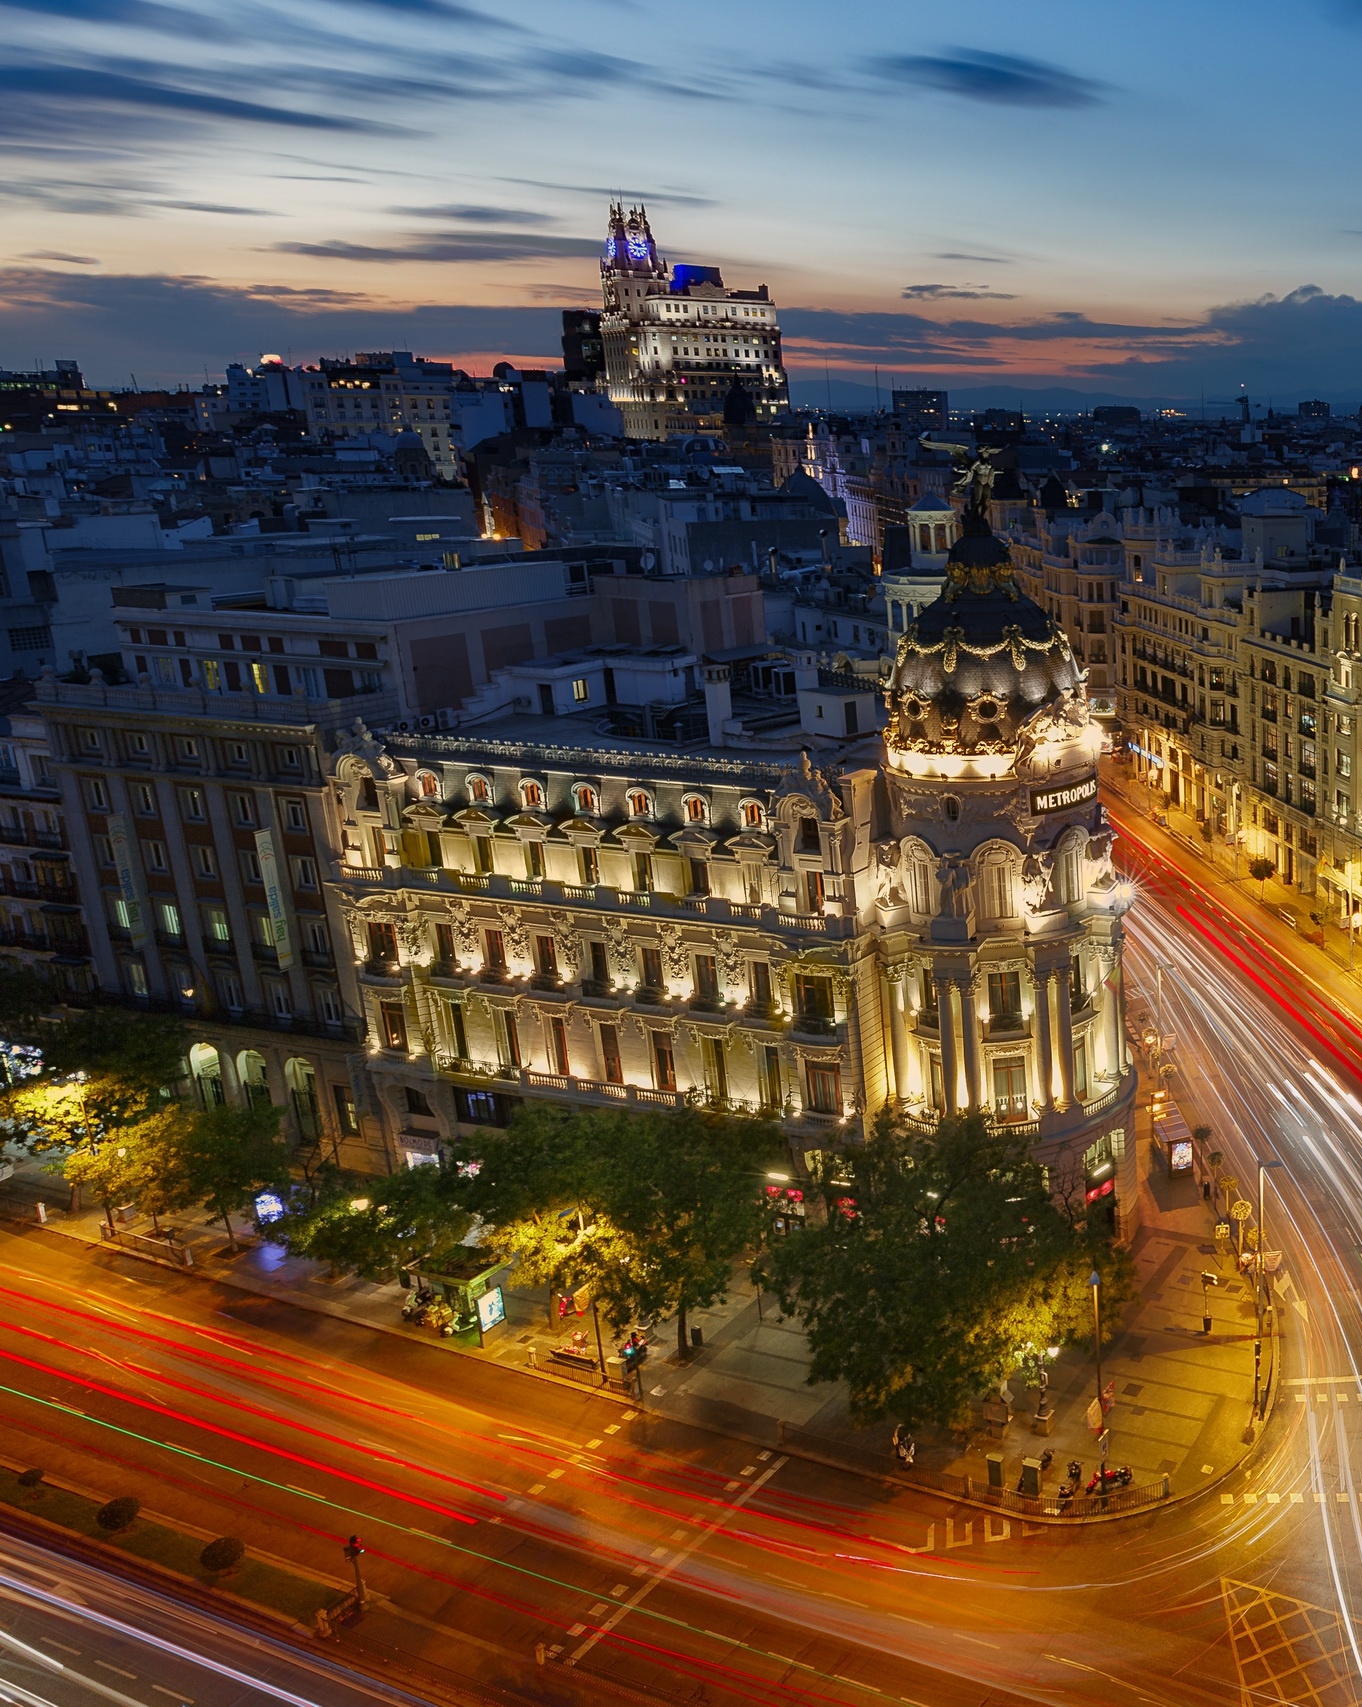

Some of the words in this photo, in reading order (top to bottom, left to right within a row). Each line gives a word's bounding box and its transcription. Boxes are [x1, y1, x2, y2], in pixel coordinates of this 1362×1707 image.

[1036, 779, 1096, 810] METROPOLIS
[120, 868, 135, 900] salida
[267, 885, 281, 919] salida
[274, 919, 287, 943] hay
